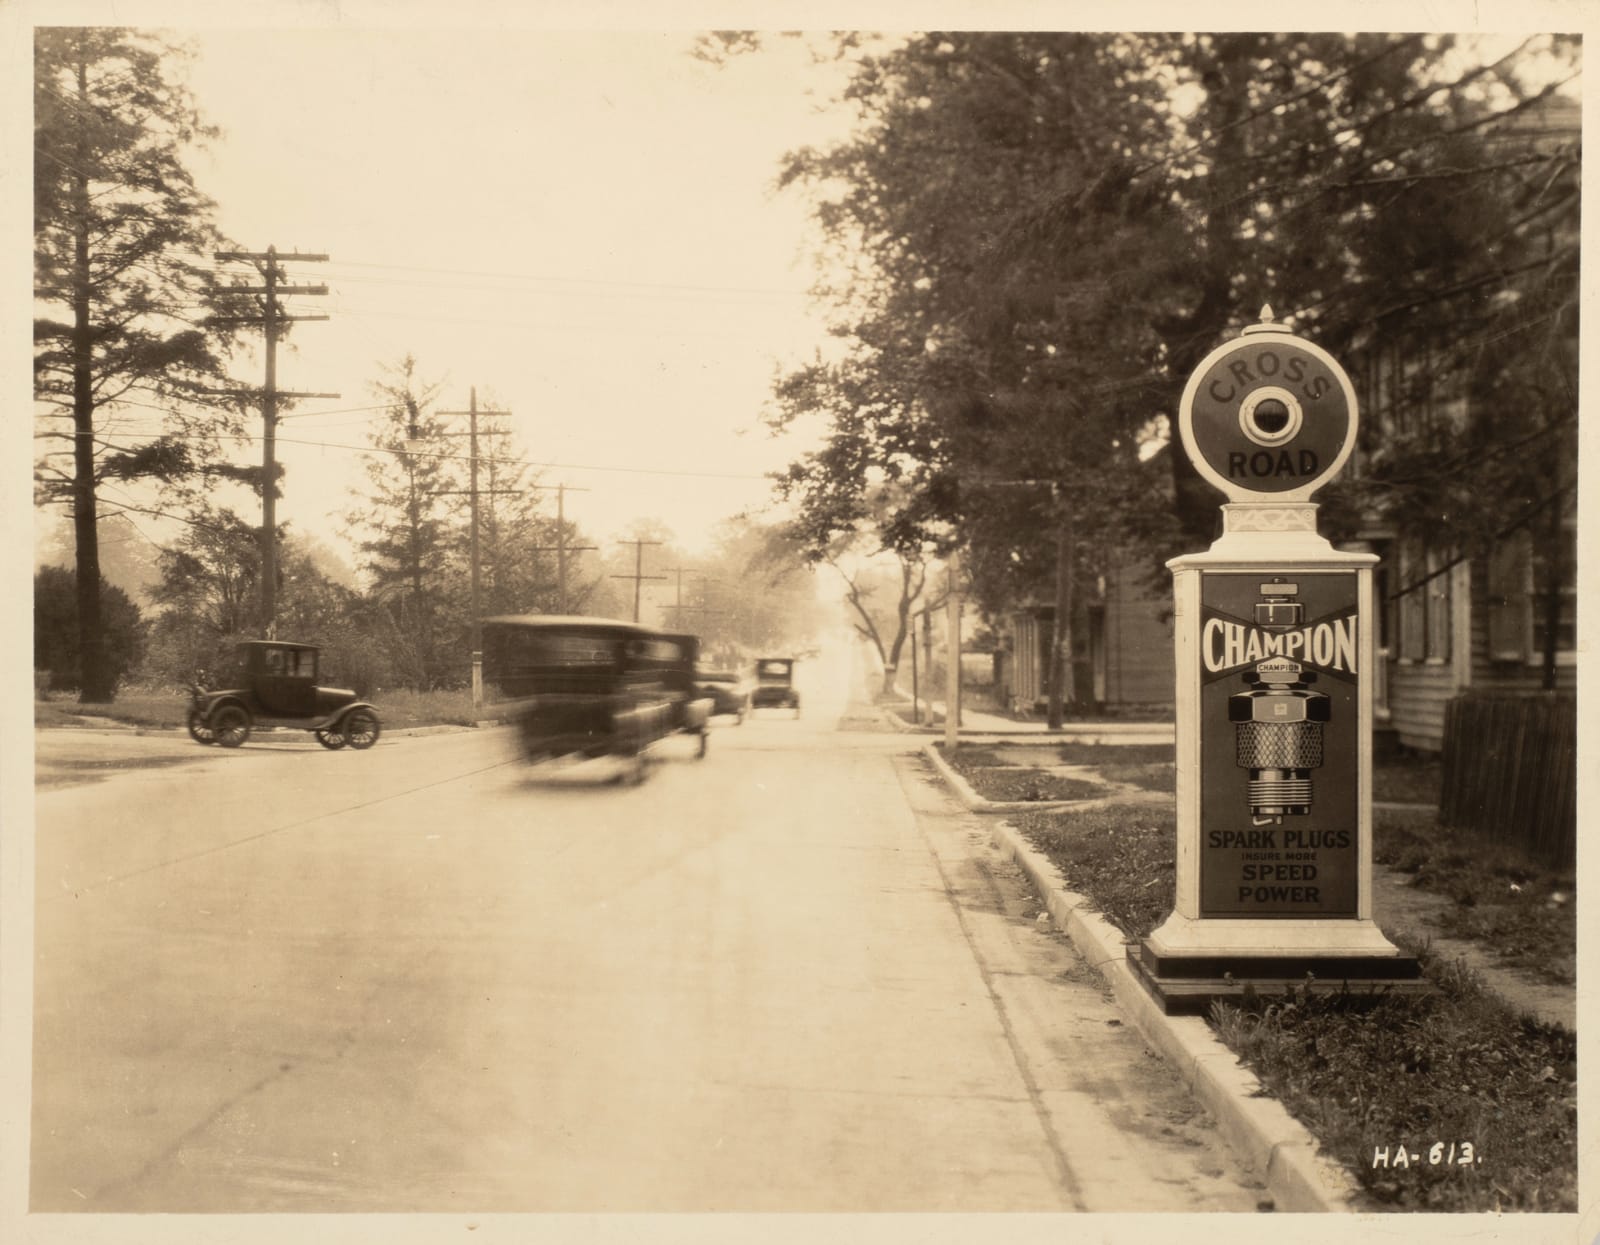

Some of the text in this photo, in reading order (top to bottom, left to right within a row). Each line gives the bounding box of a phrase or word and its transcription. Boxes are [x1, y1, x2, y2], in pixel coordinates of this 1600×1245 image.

[1209, 351, 1331, 403] CROSS
[1229, 449, 1318, 478] ROAD
[1203, 615, 1358, 674] CHAMPION
[1258, 664, 1300, 672] CHAMPION
[1209, 830, 1350, 849] SPARK PLUGS
[1242, 852, 1317, 860] INSURE MORE
[1242, 864, 1317, 881] SPEED
[1238, 886, 1320, 903] POWER
